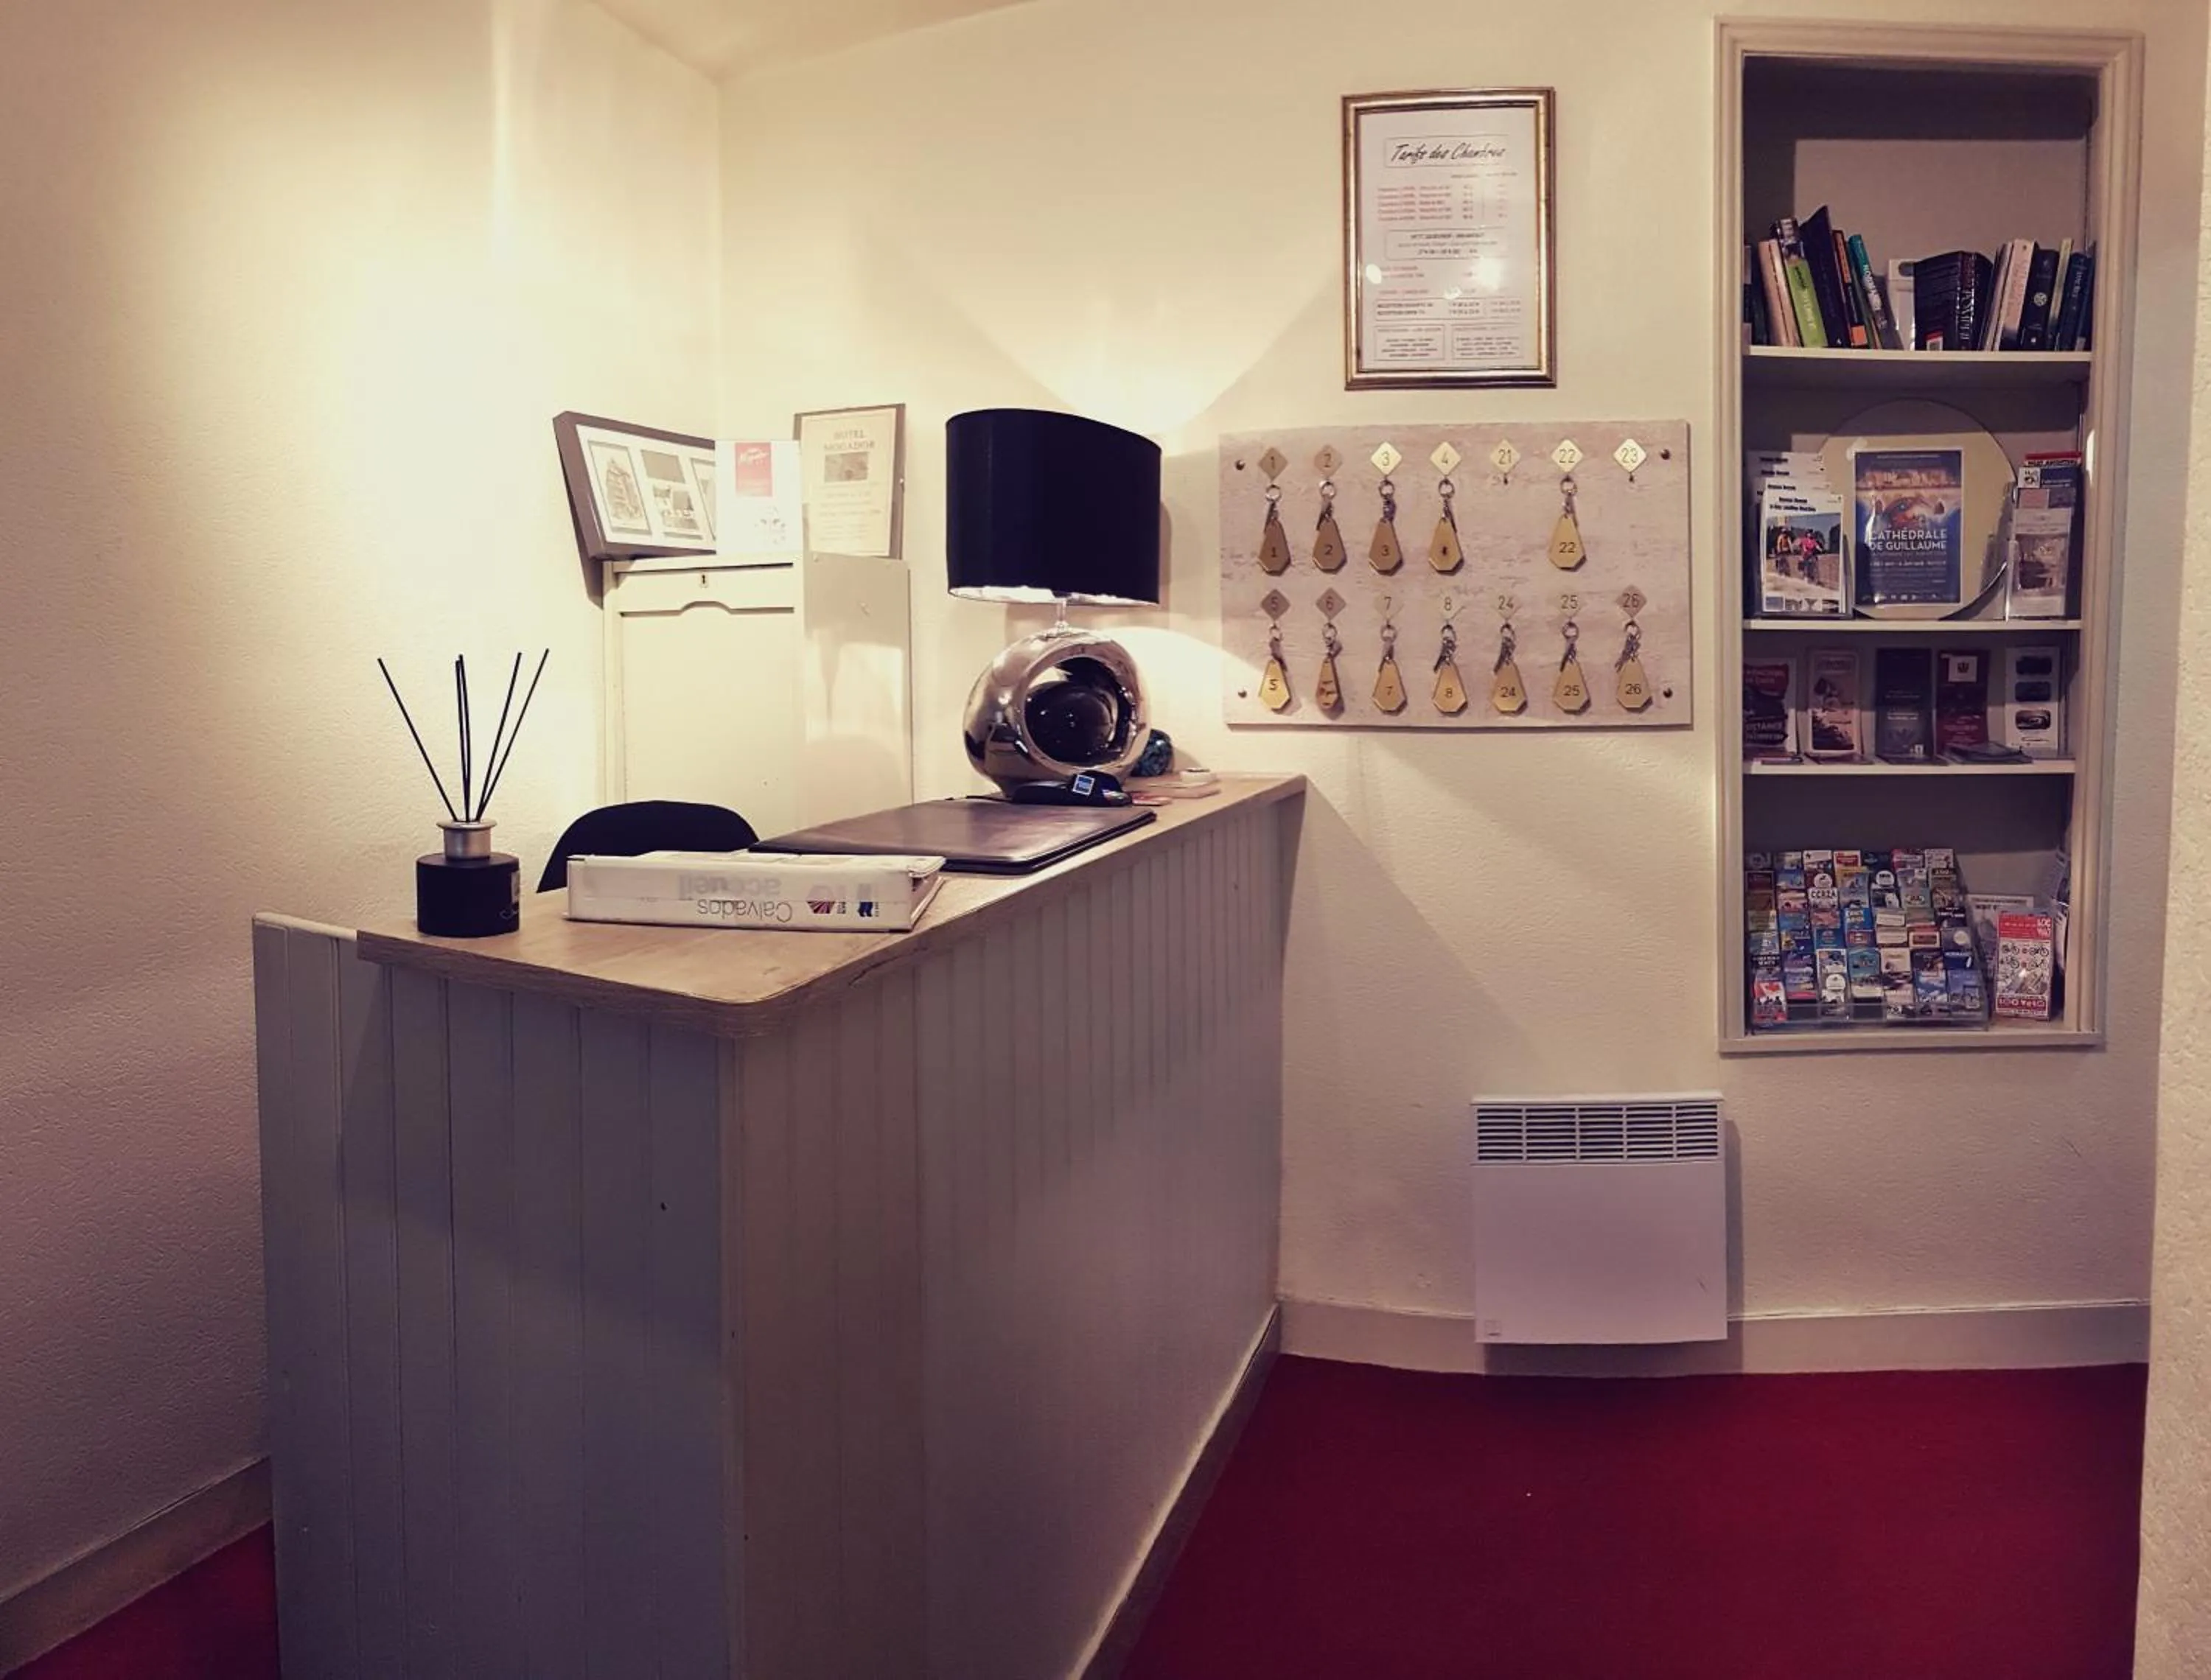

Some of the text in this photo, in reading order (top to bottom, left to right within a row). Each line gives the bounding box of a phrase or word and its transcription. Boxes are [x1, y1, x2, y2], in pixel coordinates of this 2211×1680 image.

[1324, 452, 1332, 469] 2
[1381, 450, 1391, 467] 3
[1441, 451, 1449, 466] 4
[1498, 449, 1512, 465] 21
[1559, 449, 1576, 464] 22
[1621, 447, 1639, 464] 23
[1870, 525, 1948, 541] CATHÉDRALE
[1324, 544, 1334, 556] 2
[1381, 545, 1391, 557] 3
[1559, 541, 1576, 554] 22
[1870, 540, 1947, 552] DE GUILLAUME
[1383, 596, 1392, 610] 7
[1444, 596, 1452, 612] 8
[1498, 595, 1515, 611] 24
[1560, 594, 1579, 610] 25
[1622, 592, 1640, 609] 26
[1270, 678, 1280, 691] 5
[1386, 685, 1394, 697] 7
[1563, 684, 1581, 697] 25
[1624, 682, 1643, 696] 26
[1445, 687, 1453, 699] 8
[1500, 686, 1517, 699] 24
[677, 874, 783, 900] accueil
[696, 898, 793, 923] Calvados
